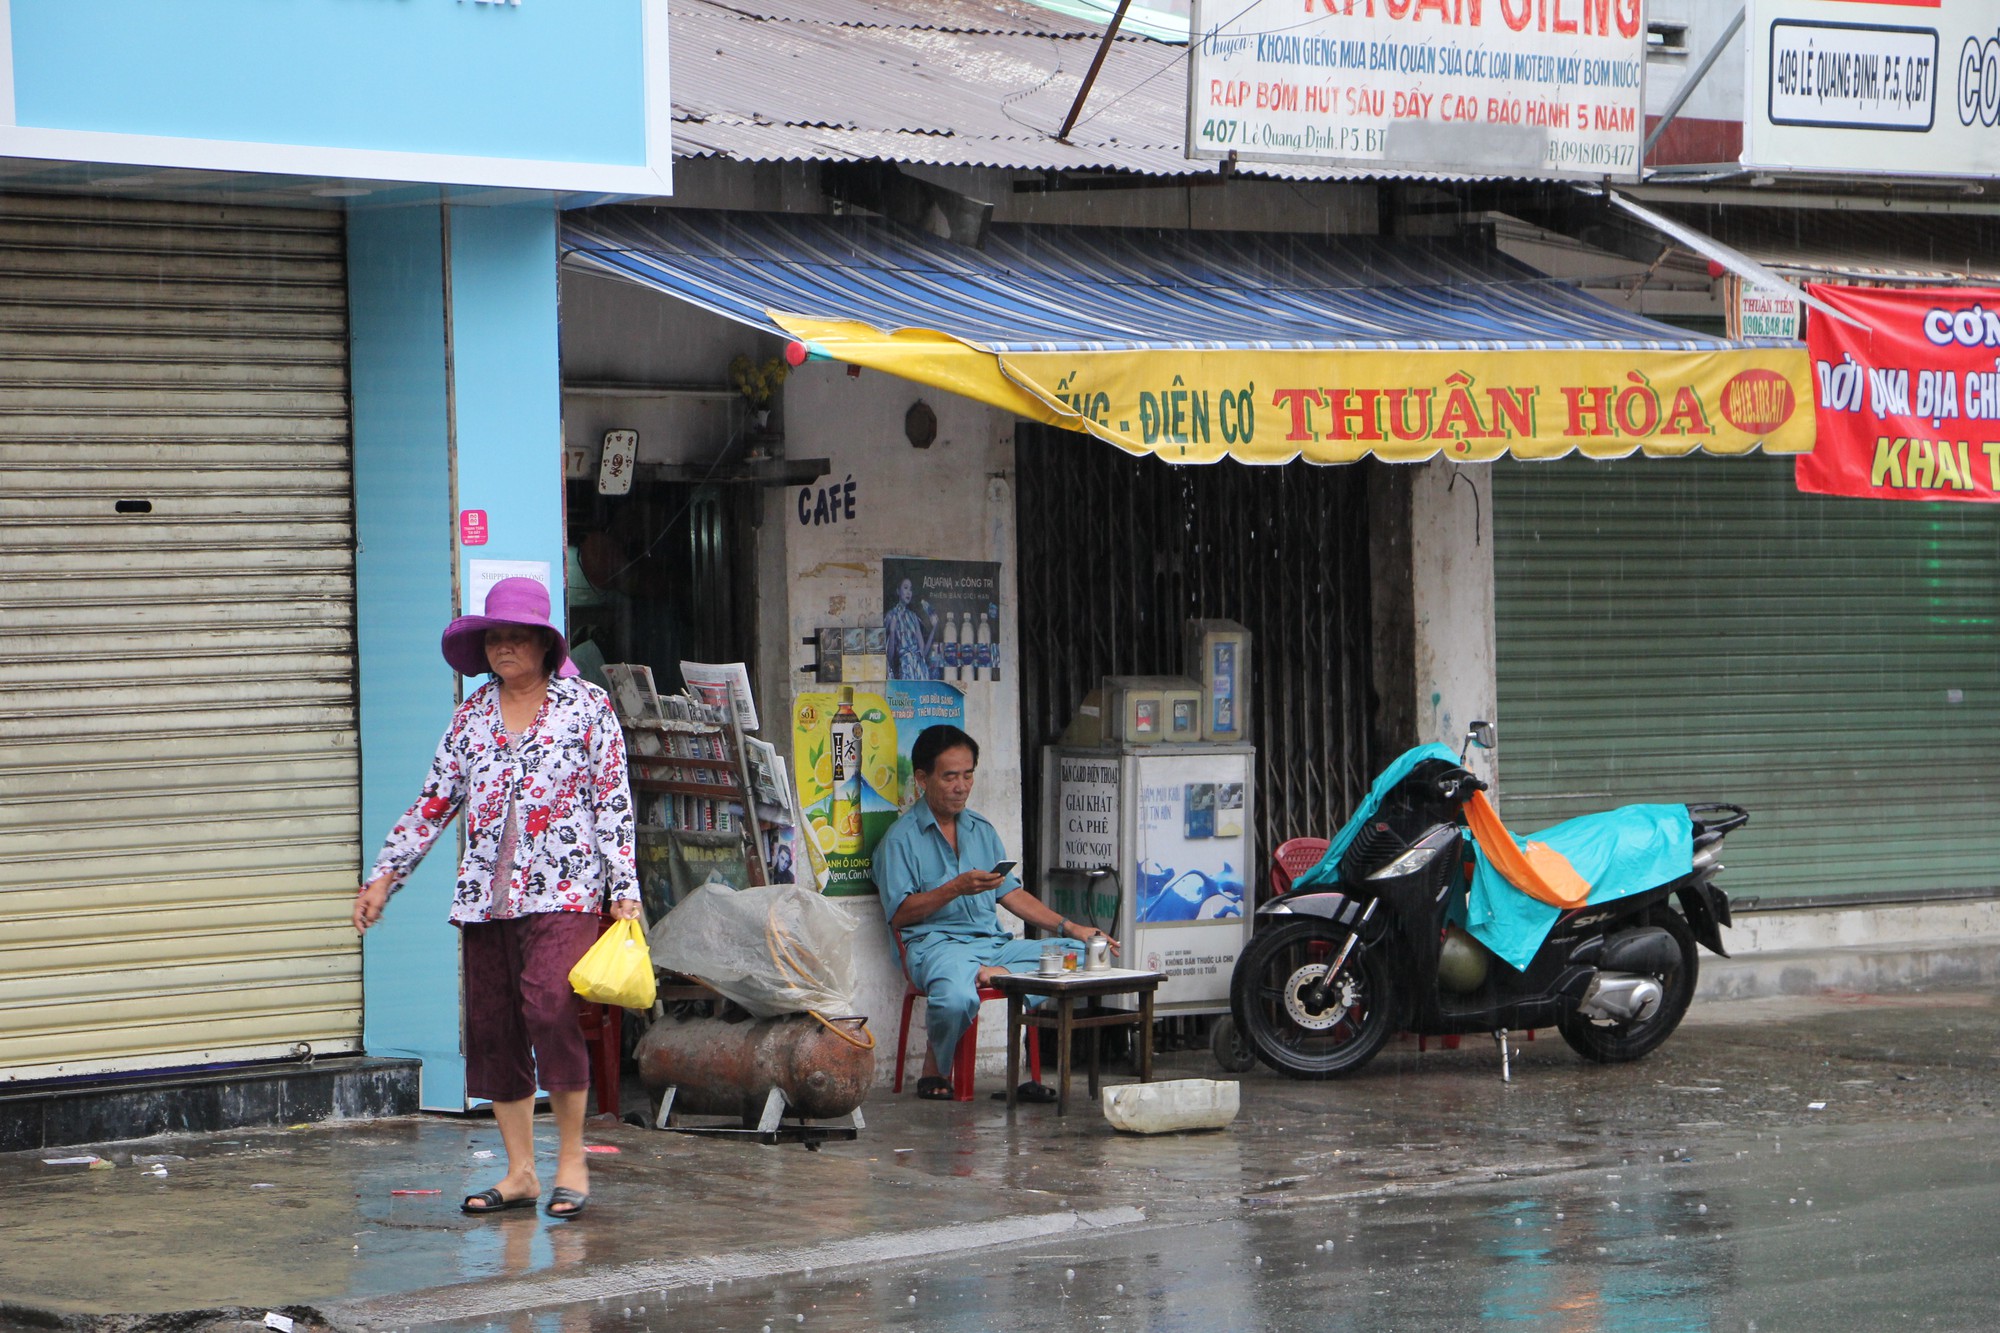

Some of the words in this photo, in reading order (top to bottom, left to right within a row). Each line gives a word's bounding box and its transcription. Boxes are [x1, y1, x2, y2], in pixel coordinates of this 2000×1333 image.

[1257, 32, 1300, 66] KHOAN
[1340, 40, 1366, 69] MUA
[1465, 42, 1488, 79] CÁC
[1489, 51, 1512, 83] LOẠI
[1514, 53, 1556, 83] MOTEUR
[1556, 49, 1581, 84] MÁY
[1584, 57, 1611, 88] BƠM
[1778, 48, 1797, 96] 409
[1800, 37, 1813, 96] LÊ
[1816, 50, 1851, 105] QUANG
[1210, 71, 1252, 108] RÁP
[1305, 76, 1340, 114] HÚT
[1393, 82, 1434, 119] ĐẨY
[1487, 90, 1521, 125] BẢO
[1526, 94, 1570, 129] HÀNH
[1577, 103, 1590, 131] 5
[1594, 101, 1636, 133] NĂM
[1203, 119, 1238, 144] 407
[1262, 122, 1302, 152] Quang
[1743, 296, 1773, 316] THUẬN
[1774, 294, 1795, 314] TIẾN
[1817, 352, 1864, 413] DỜI
[1868, 368, 1911, 420] QUA
[1916, 369, 1959, 430] ĐỊA
[1139, 374, 1210, 455] ĐIỆN
[1219, 380, 1254, 444] CƠ
[1272, 368, 1539, 454] THUẬN
[1561, 368, 1716, 437] HÒA
[1871, 437, 1976, 491] KHAI
[798, 474, 857, 526] CAFÉ
[922, 575, 954, 590] AQUAFINA
[960, 576, 982, 588] CÔNG
[1062, 759, 1073, 783] BÁN
[1073, 765, 1086, 783] CARD
[1066, 789, 1084, 811] GIẢI
[1086, 790, 1112, 812] KHÁT
[1069, 815, 1084, 833] CÀ
[1086, 817, 1109, 834] PHÊ
[850, 858, 870, 868] LONG
[1065, 838, 1088, 856] NƯỚC
[1089, 842, 1112, 860] NGỌT
